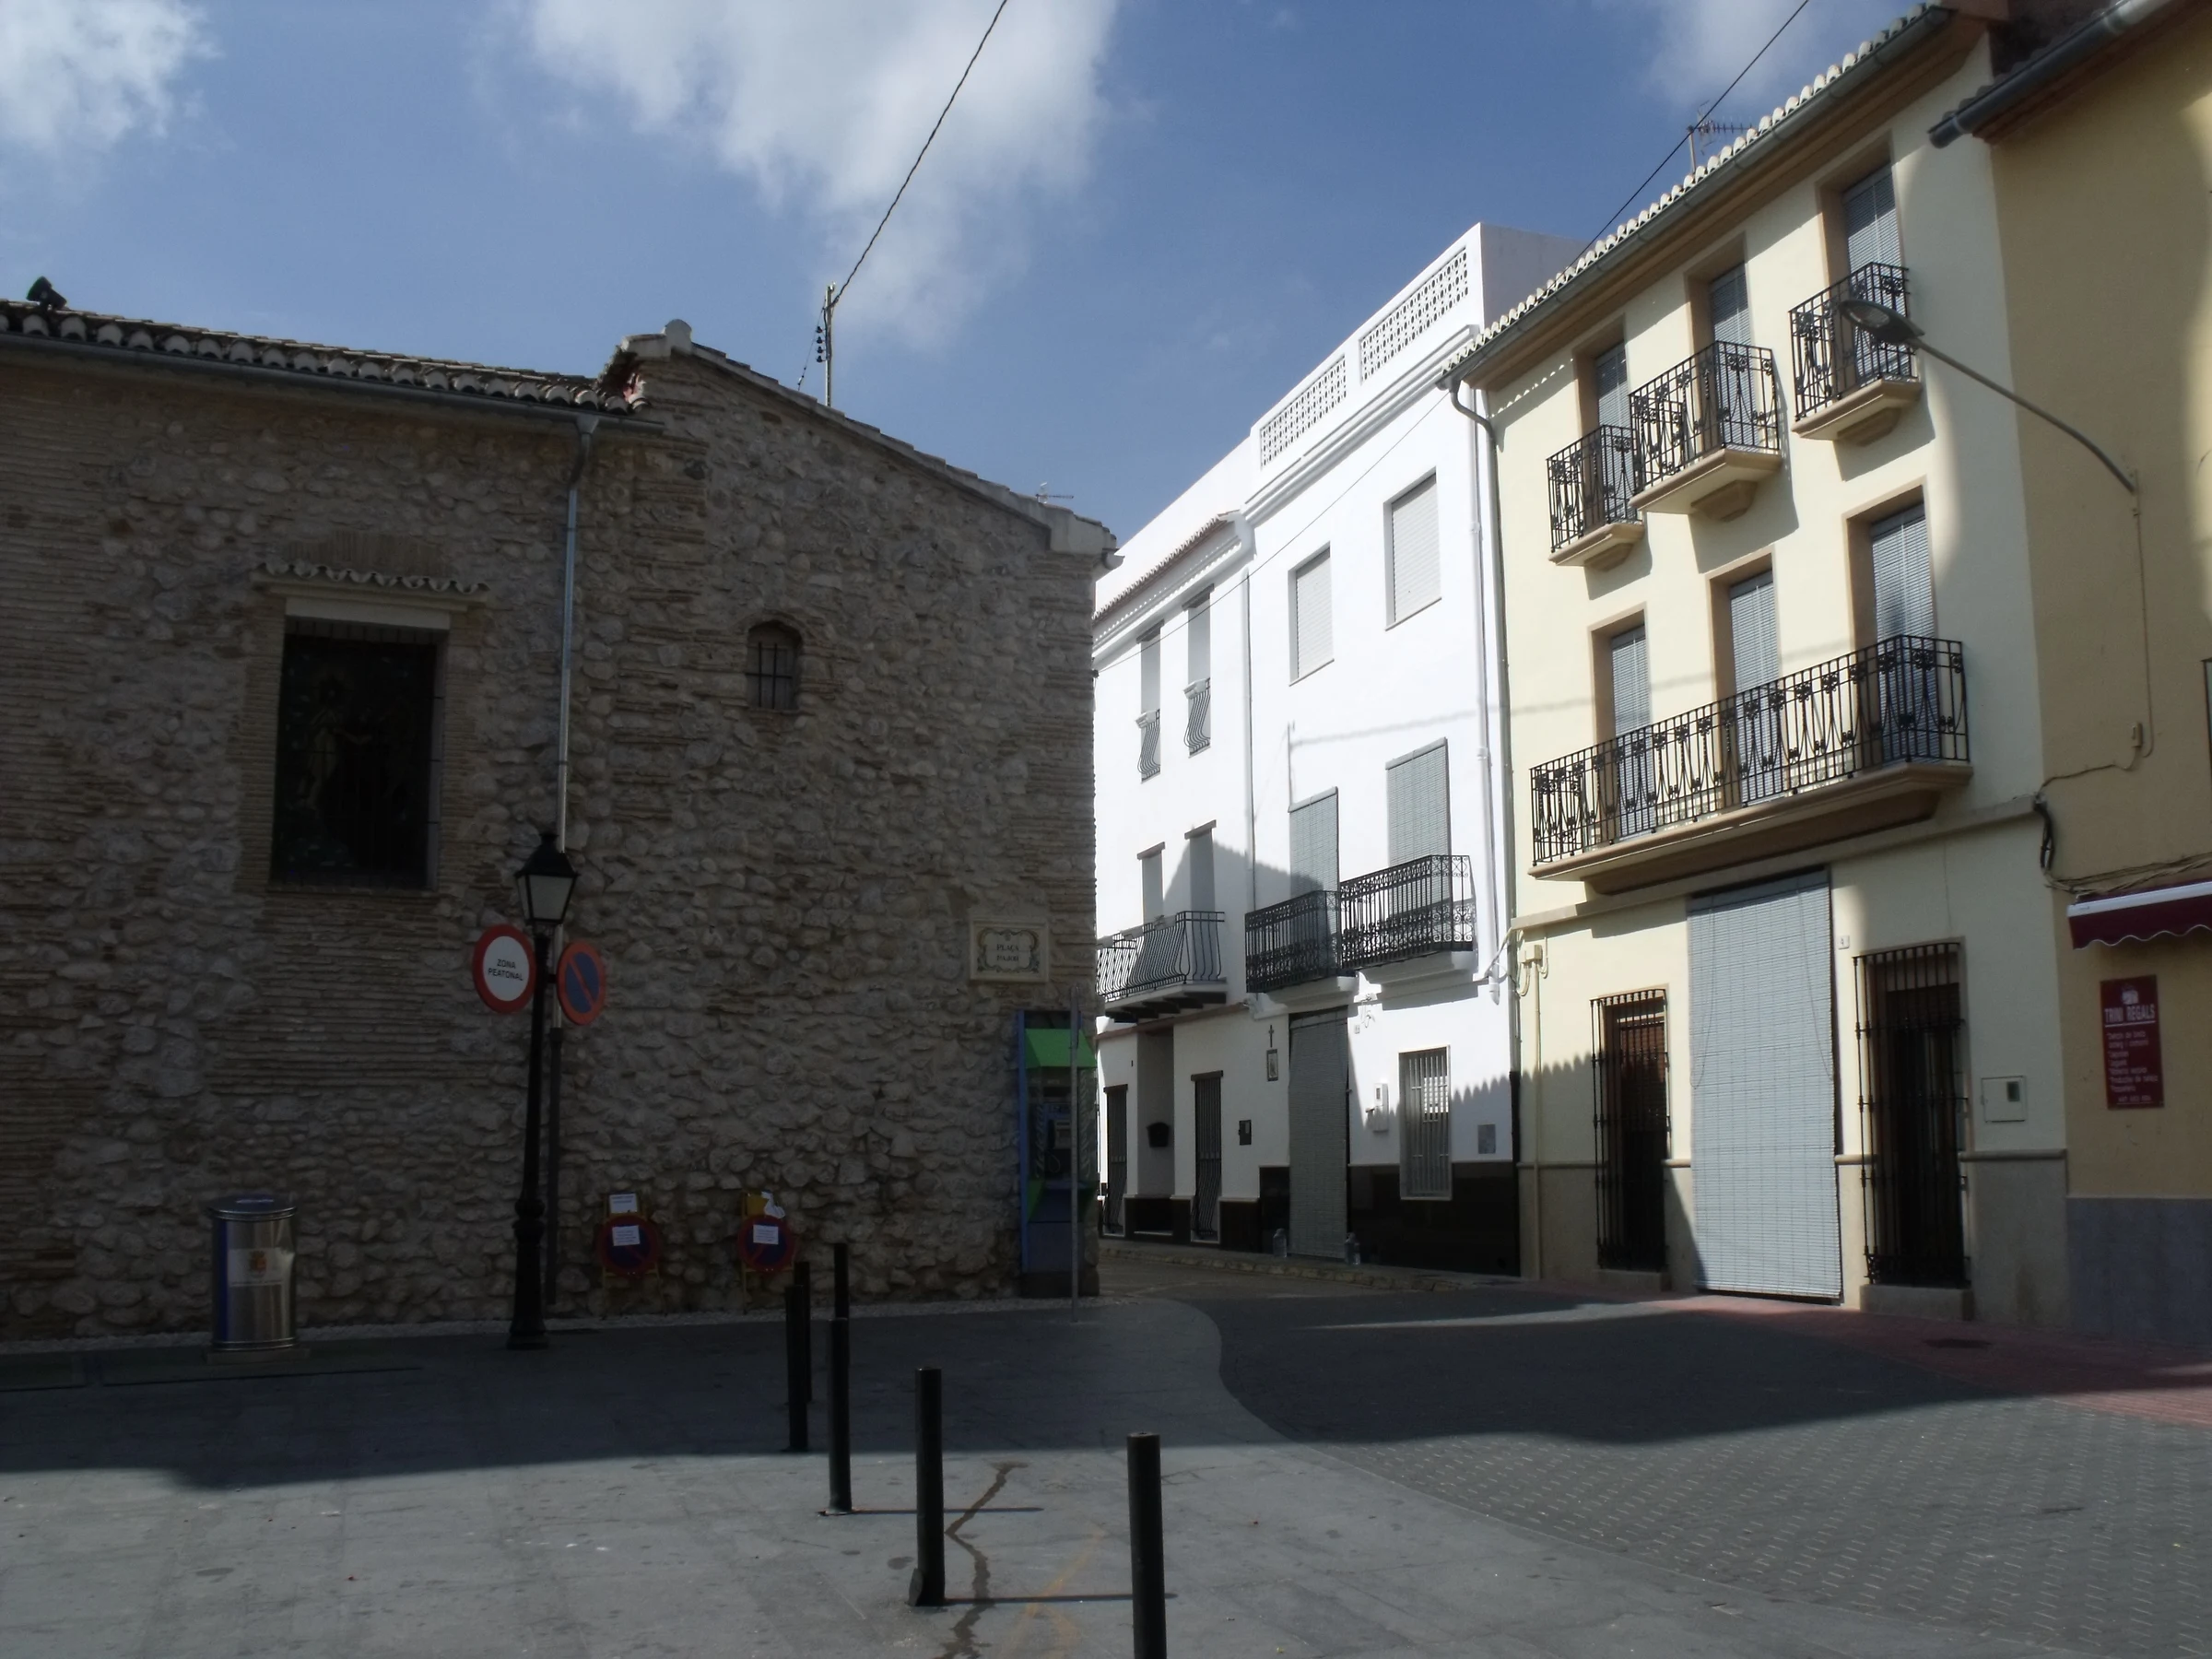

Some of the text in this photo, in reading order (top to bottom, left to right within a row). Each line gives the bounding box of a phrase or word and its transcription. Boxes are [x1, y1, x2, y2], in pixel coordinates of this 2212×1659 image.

[996, 944, 1019, 953] PLAÇA
[497, 959, 516, 969] ZONA
[488, 968, 524, 982] PEATONAL
[2104, 1003, 2156, 1023] TRINI REGALS
